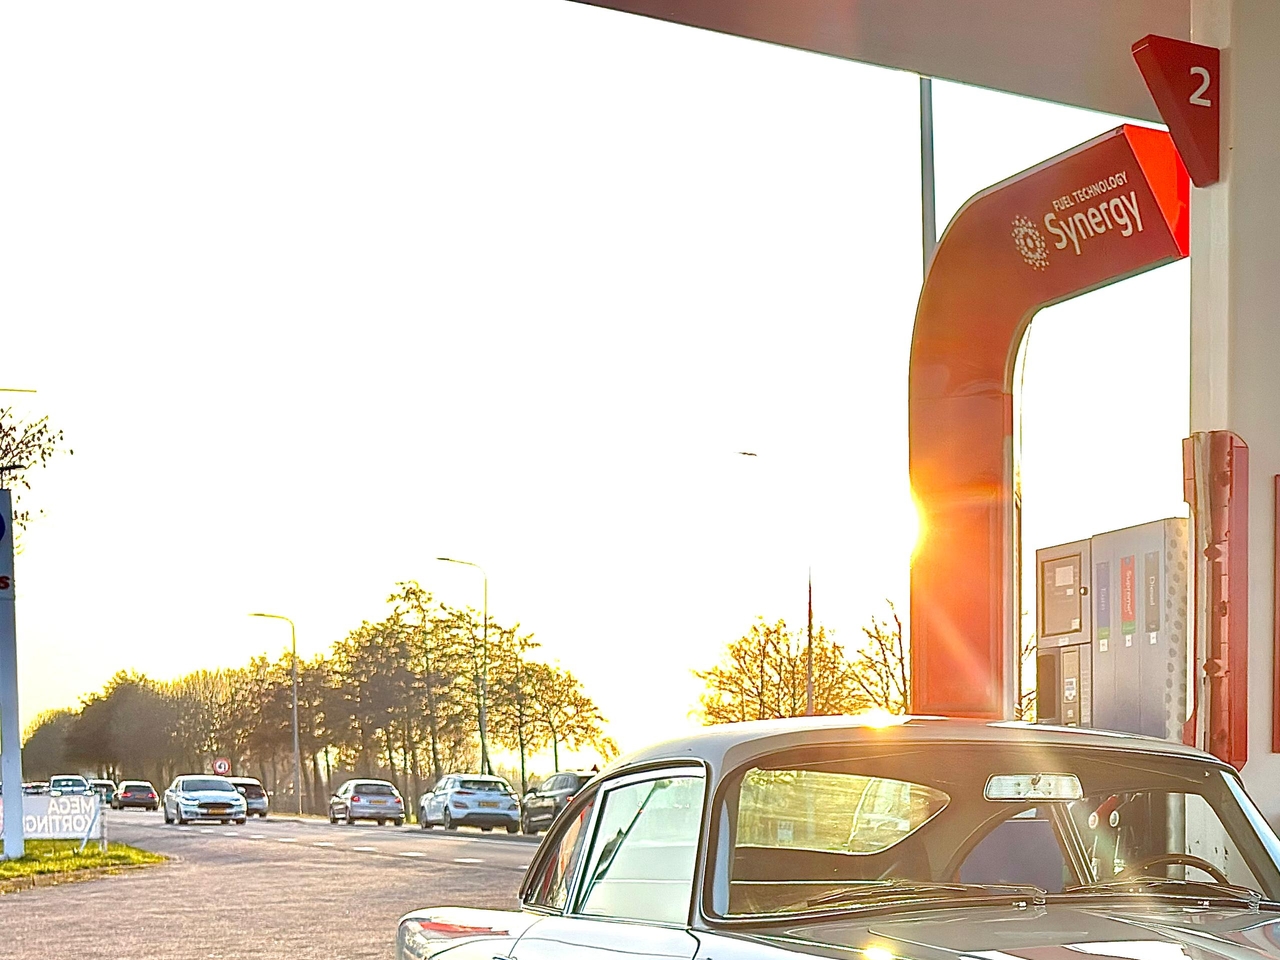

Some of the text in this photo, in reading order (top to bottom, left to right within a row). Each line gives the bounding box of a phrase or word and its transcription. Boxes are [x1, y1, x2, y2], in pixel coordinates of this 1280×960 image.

[1189, 66, 1211, 107] 2
[1052, 171, 1128, 212] FUEL TECHNOLOGY
[1044, 191, 1143, 255] Synergy
